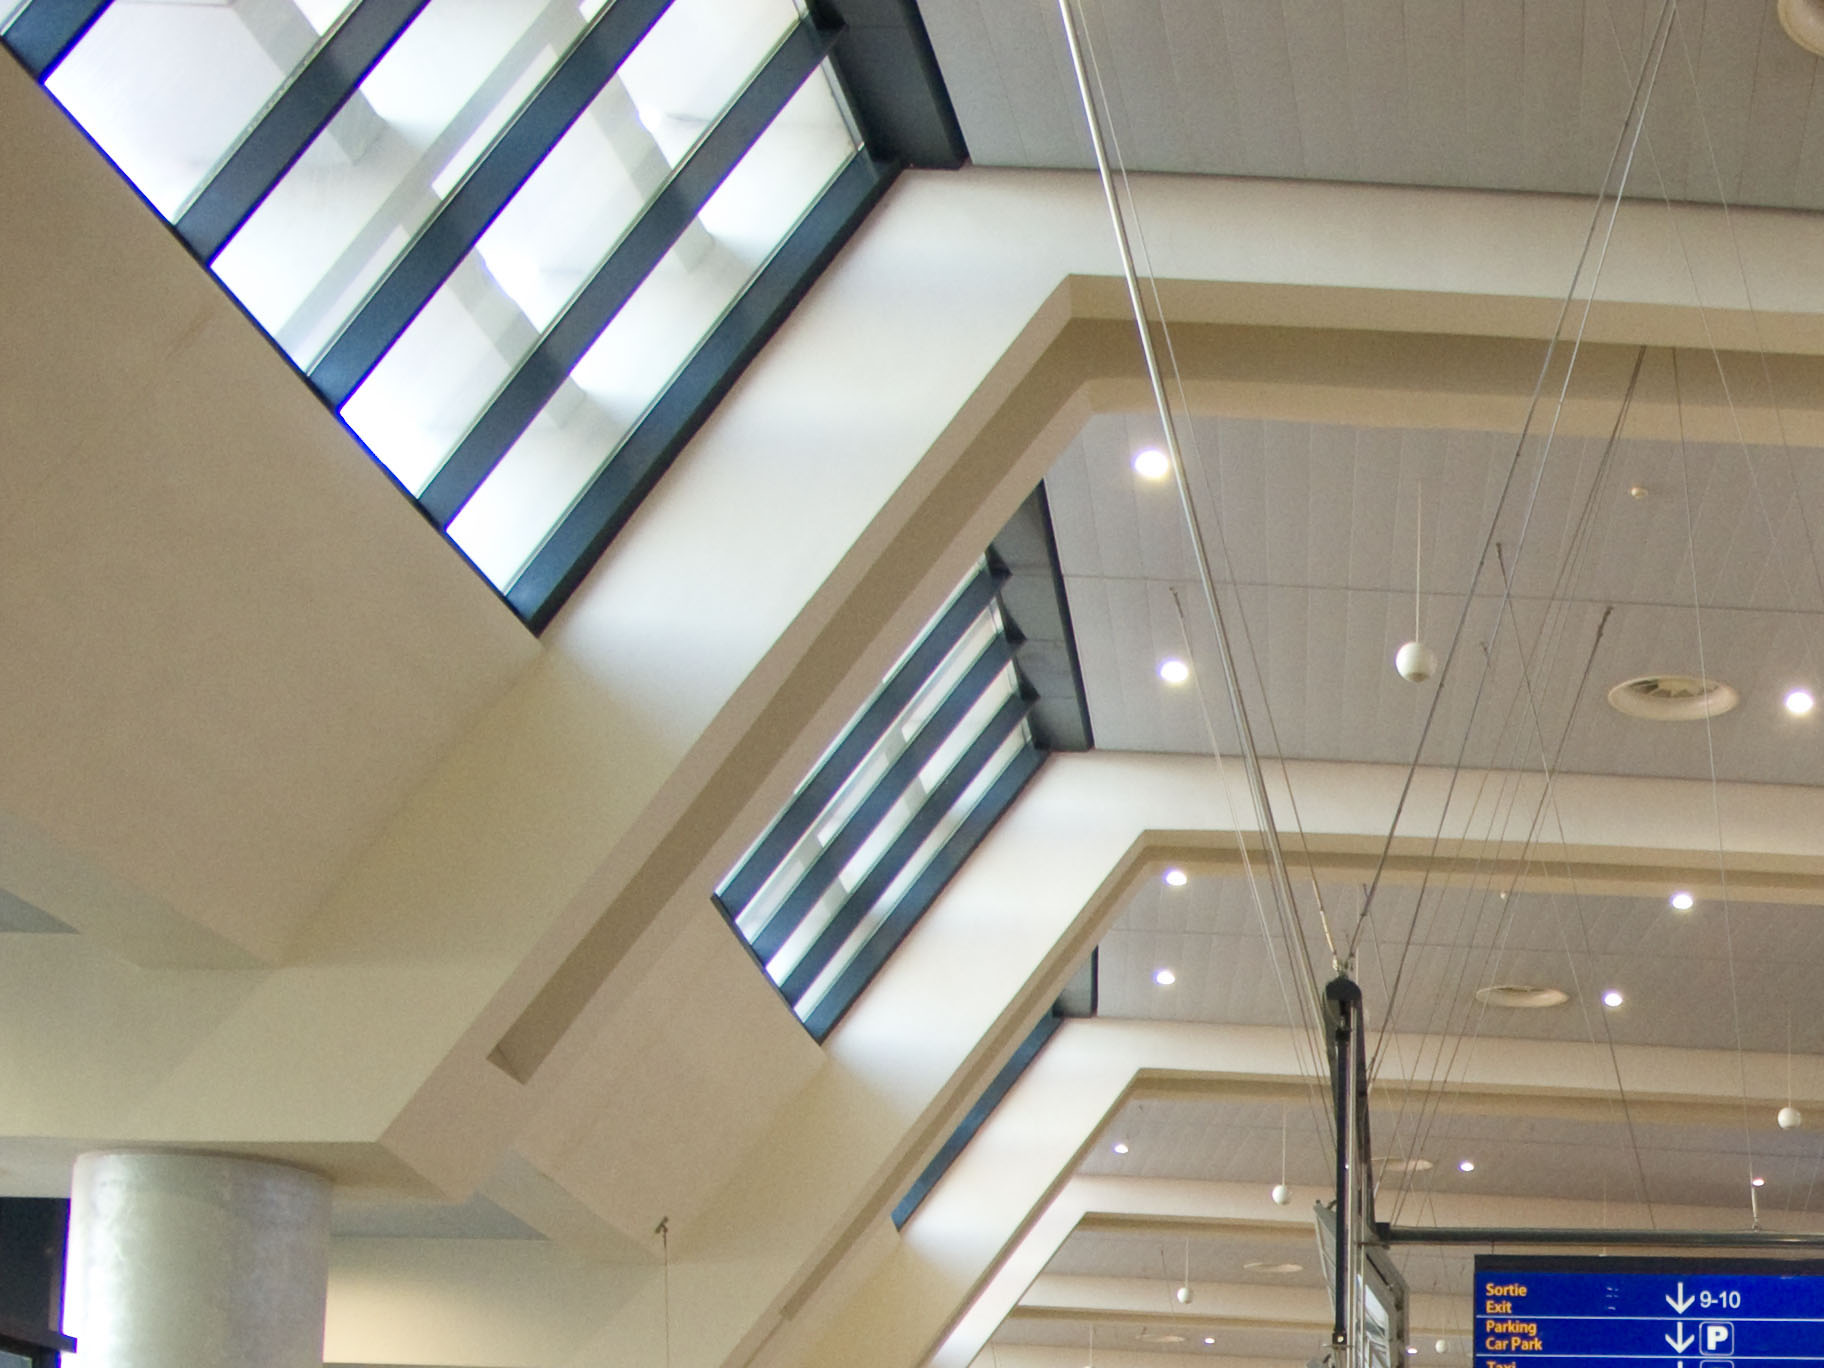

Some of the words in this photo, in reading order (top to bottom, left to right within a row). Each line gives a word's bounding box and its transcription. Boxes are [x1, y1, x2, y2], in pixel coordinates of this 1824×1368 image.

[1485, 1282, 1527, 1297] Sortie
[1699, 1290, 1741, 1309] 9-10
[1485, 1301, 1512, 1314] Exit
[1485, 1320, 1538, 1336] Parking
[1485, 1337, 1508, 1351] Car
[1510, 1337, 1543, 1351] Park
[1706, 1325, 1729, 1350] P
